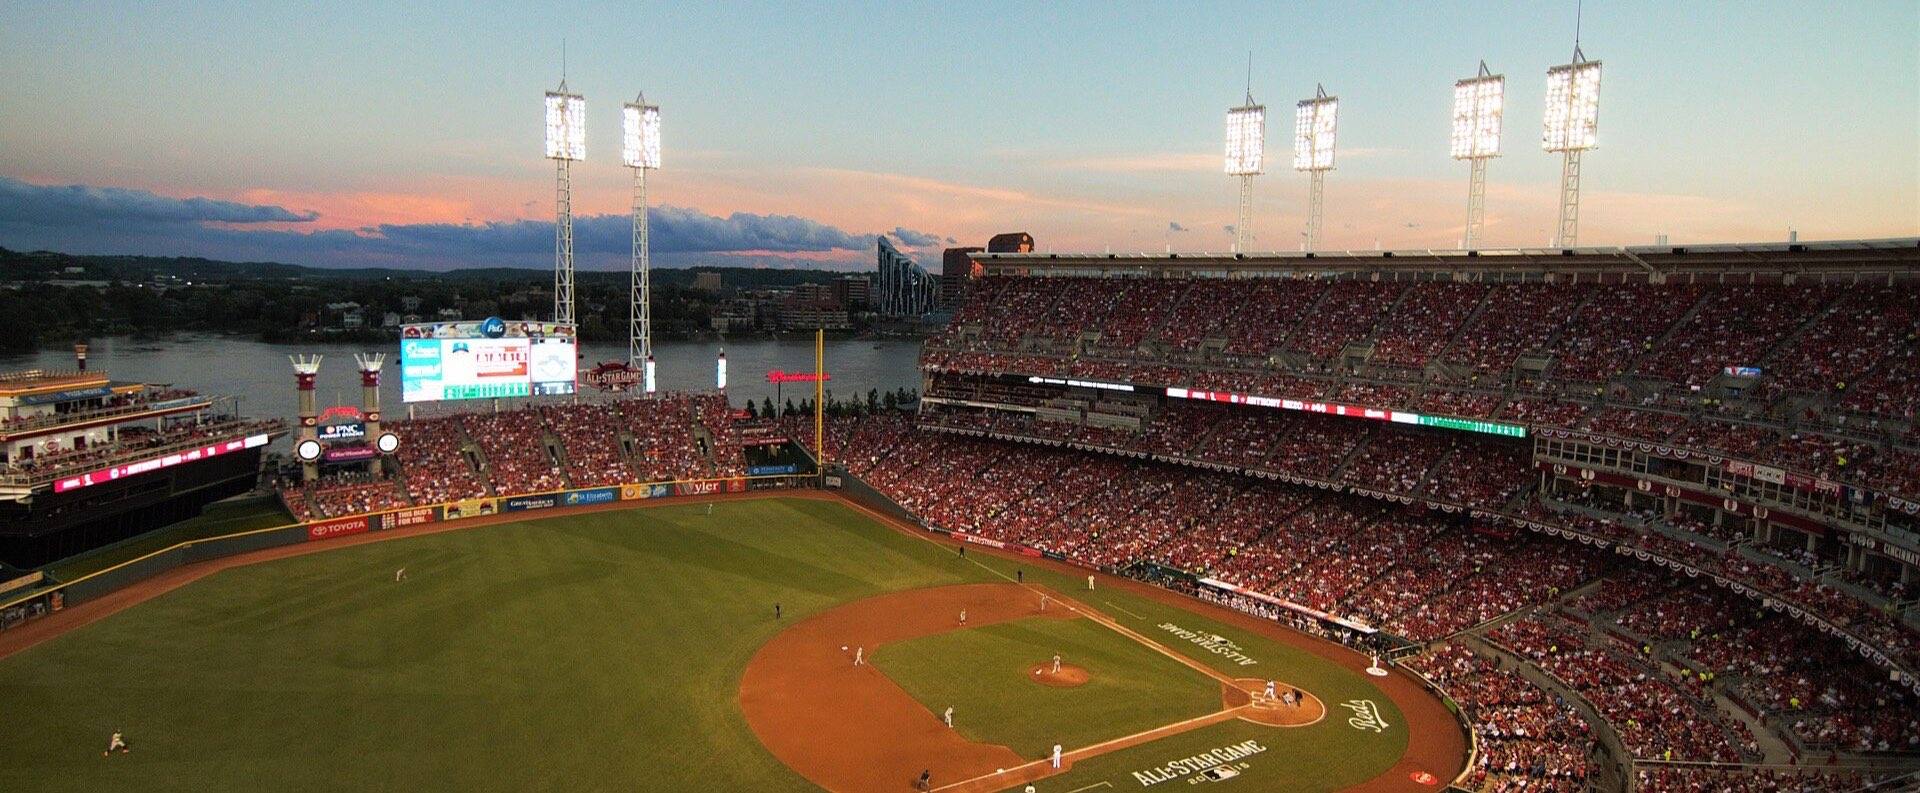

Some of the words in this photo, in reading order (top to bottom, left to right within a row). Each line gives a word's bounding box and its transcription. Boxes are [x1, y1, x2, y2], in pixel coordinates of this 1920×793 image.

[487, 324, 503, 332] P&G
[621, 370, 641, 382] GAME
[335, 424, 358, 435] PNC
[676, 481, 719, 496] Wyler
[414, 509, 432, 517] BUD'S
[328, 520, 366, 533] TOYOTA
[398, 518, 410, 526] FOR
[1340, 699, 1390, 733] Reds
[1211, 739, 1267, 762] GAME
